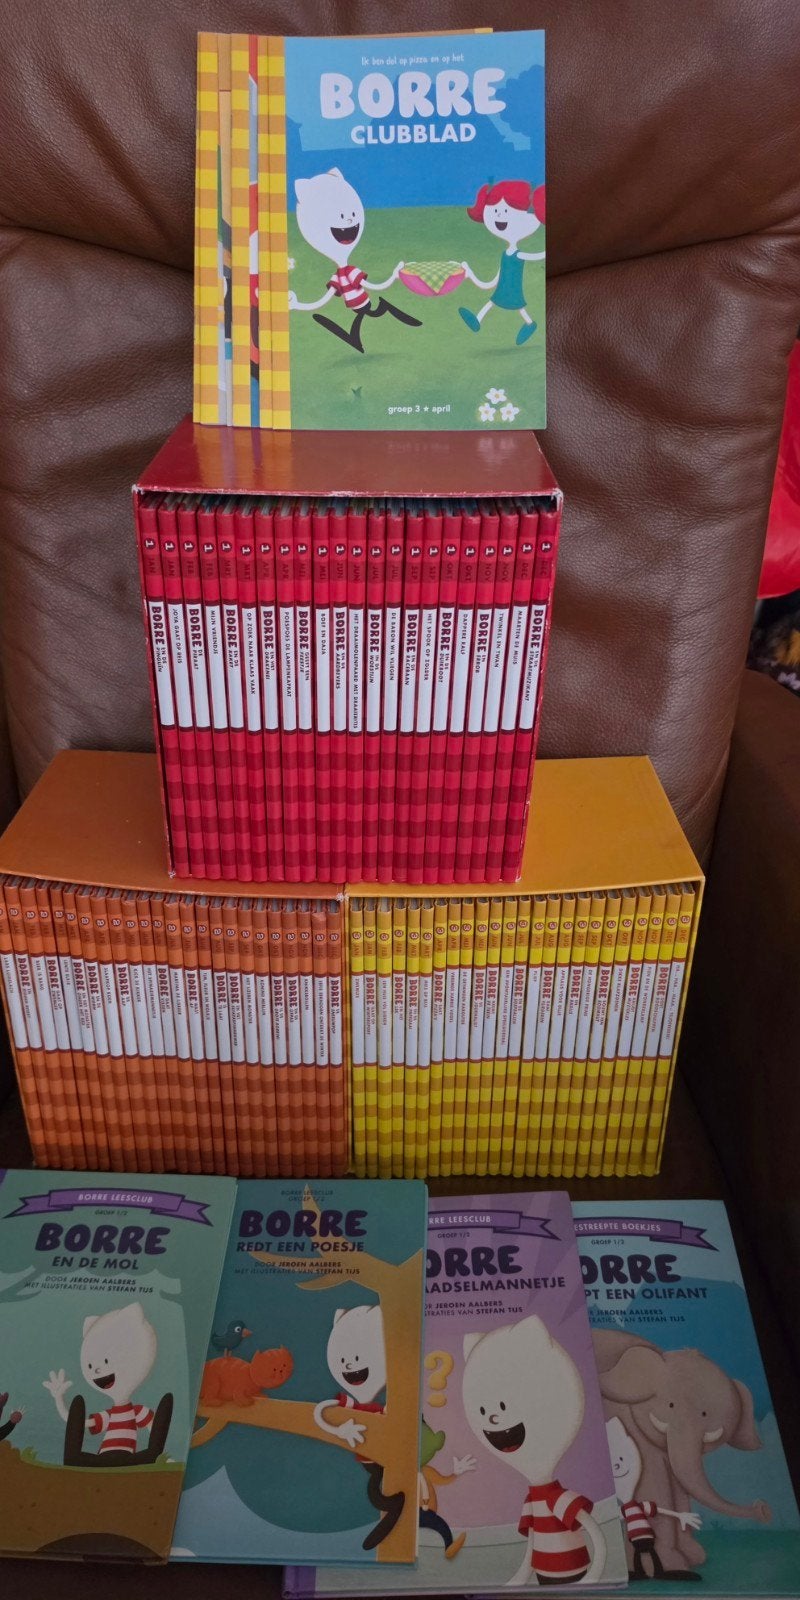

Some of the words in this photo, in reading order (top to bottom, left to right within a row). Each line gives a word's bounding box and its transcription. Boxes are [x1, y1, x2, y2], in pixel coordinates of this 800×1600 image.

[362, 57, 368, 66] Ik
[372, 57, 384, 65] ben
[386, 56, 396, 65] dol
[400, 58, 408, 66] op
[410, 57, 428, 65] pizza
[442, 56, 450, 64] op
[452, 54, 464, 62] het
[320, 68, 506, 119] BORRE
[351, 124, 476, 144] CLUBBLAD
[432, 405, 450, 414] april
[151, 606, 164, 645] BORRE
[189, 609, 202, 647] BORRE
[226, 610, 237, 648] BORRE
[263, 611, 274, 650] BORRE
[299, 611, 309, 649] BORRE
[321, 630, 326, 638] EN
[336, 612, 345, 650] BORRE
[370, 614, 379, 652] BORRE
[407, 614, 417, 652] BORRE
[440, 613, 452, 651] BORRE
[477, 614, 489, 652] BORRE
[531, 610, 543, 648] BORRE
[496, 641, 502, 649] EN
[18, 958, 30, 987] BORRE
[47, 960, 59, 988] BORRE
[73, 962, 84, 991] BORRE
[88, 966, 98, 994] BORRE
[118, 967, 127, 995] BORRE
[158, 968, 168, 996] BORRE
[488, 970, 497, 999] BORRE
[514, 969, 523, 997] BORRE
[543, 970, 552, 998] BORRE
[571, 970, 581, 998] BORRE
[599, 970, 609, 998] BORRE
[629, 967, 640, 996] BORRE
[657, 967, 668, 996] BORRE
[187, 973, 197, 1001] BORRE
[216, 975, 225, 1003] BORRE
[230, 976, 239, 1004] BORRE
[274, 980, 282, 1007] BORRE
[288, 980, 297, 1007] BORRE
[331, 980, 339, 1007] BORRE
[366, 977, 374, 1005] BORRE
[395, 977, 403, 1005] BORRE
[409, 980, 417, 1008] BORRE
[434, 974, 443, 1003] BORRE
[475, 973, 483, 1001] BORRE
[111, 1194, 153, 1203] LEESCLUB
[239, 1210, 368, 1237] BORRE
[574, 1223, 619, 1231] ESTREEPTE
[622, 1223, 661, 1231] BOEKJES
[35, 1223, 170, 1255] BORRE
[237, 1242, 272, 1252] REDT
[277, 1242, 305, 1252] EEN
[311, 1242, 364, 1252] POESJE
[52, 1257, 73, 1267] EN
[79, 1258, 98, 1268] DE
[103, 1259, 138, 1270] MOL
[426, 1245, 523, 1278] ORRE
[579, 1254, 681, 1284] ORRE
[606, 1289, 634, 1299] EEN
[642, 1288, 707, 1299] OLIFANT
